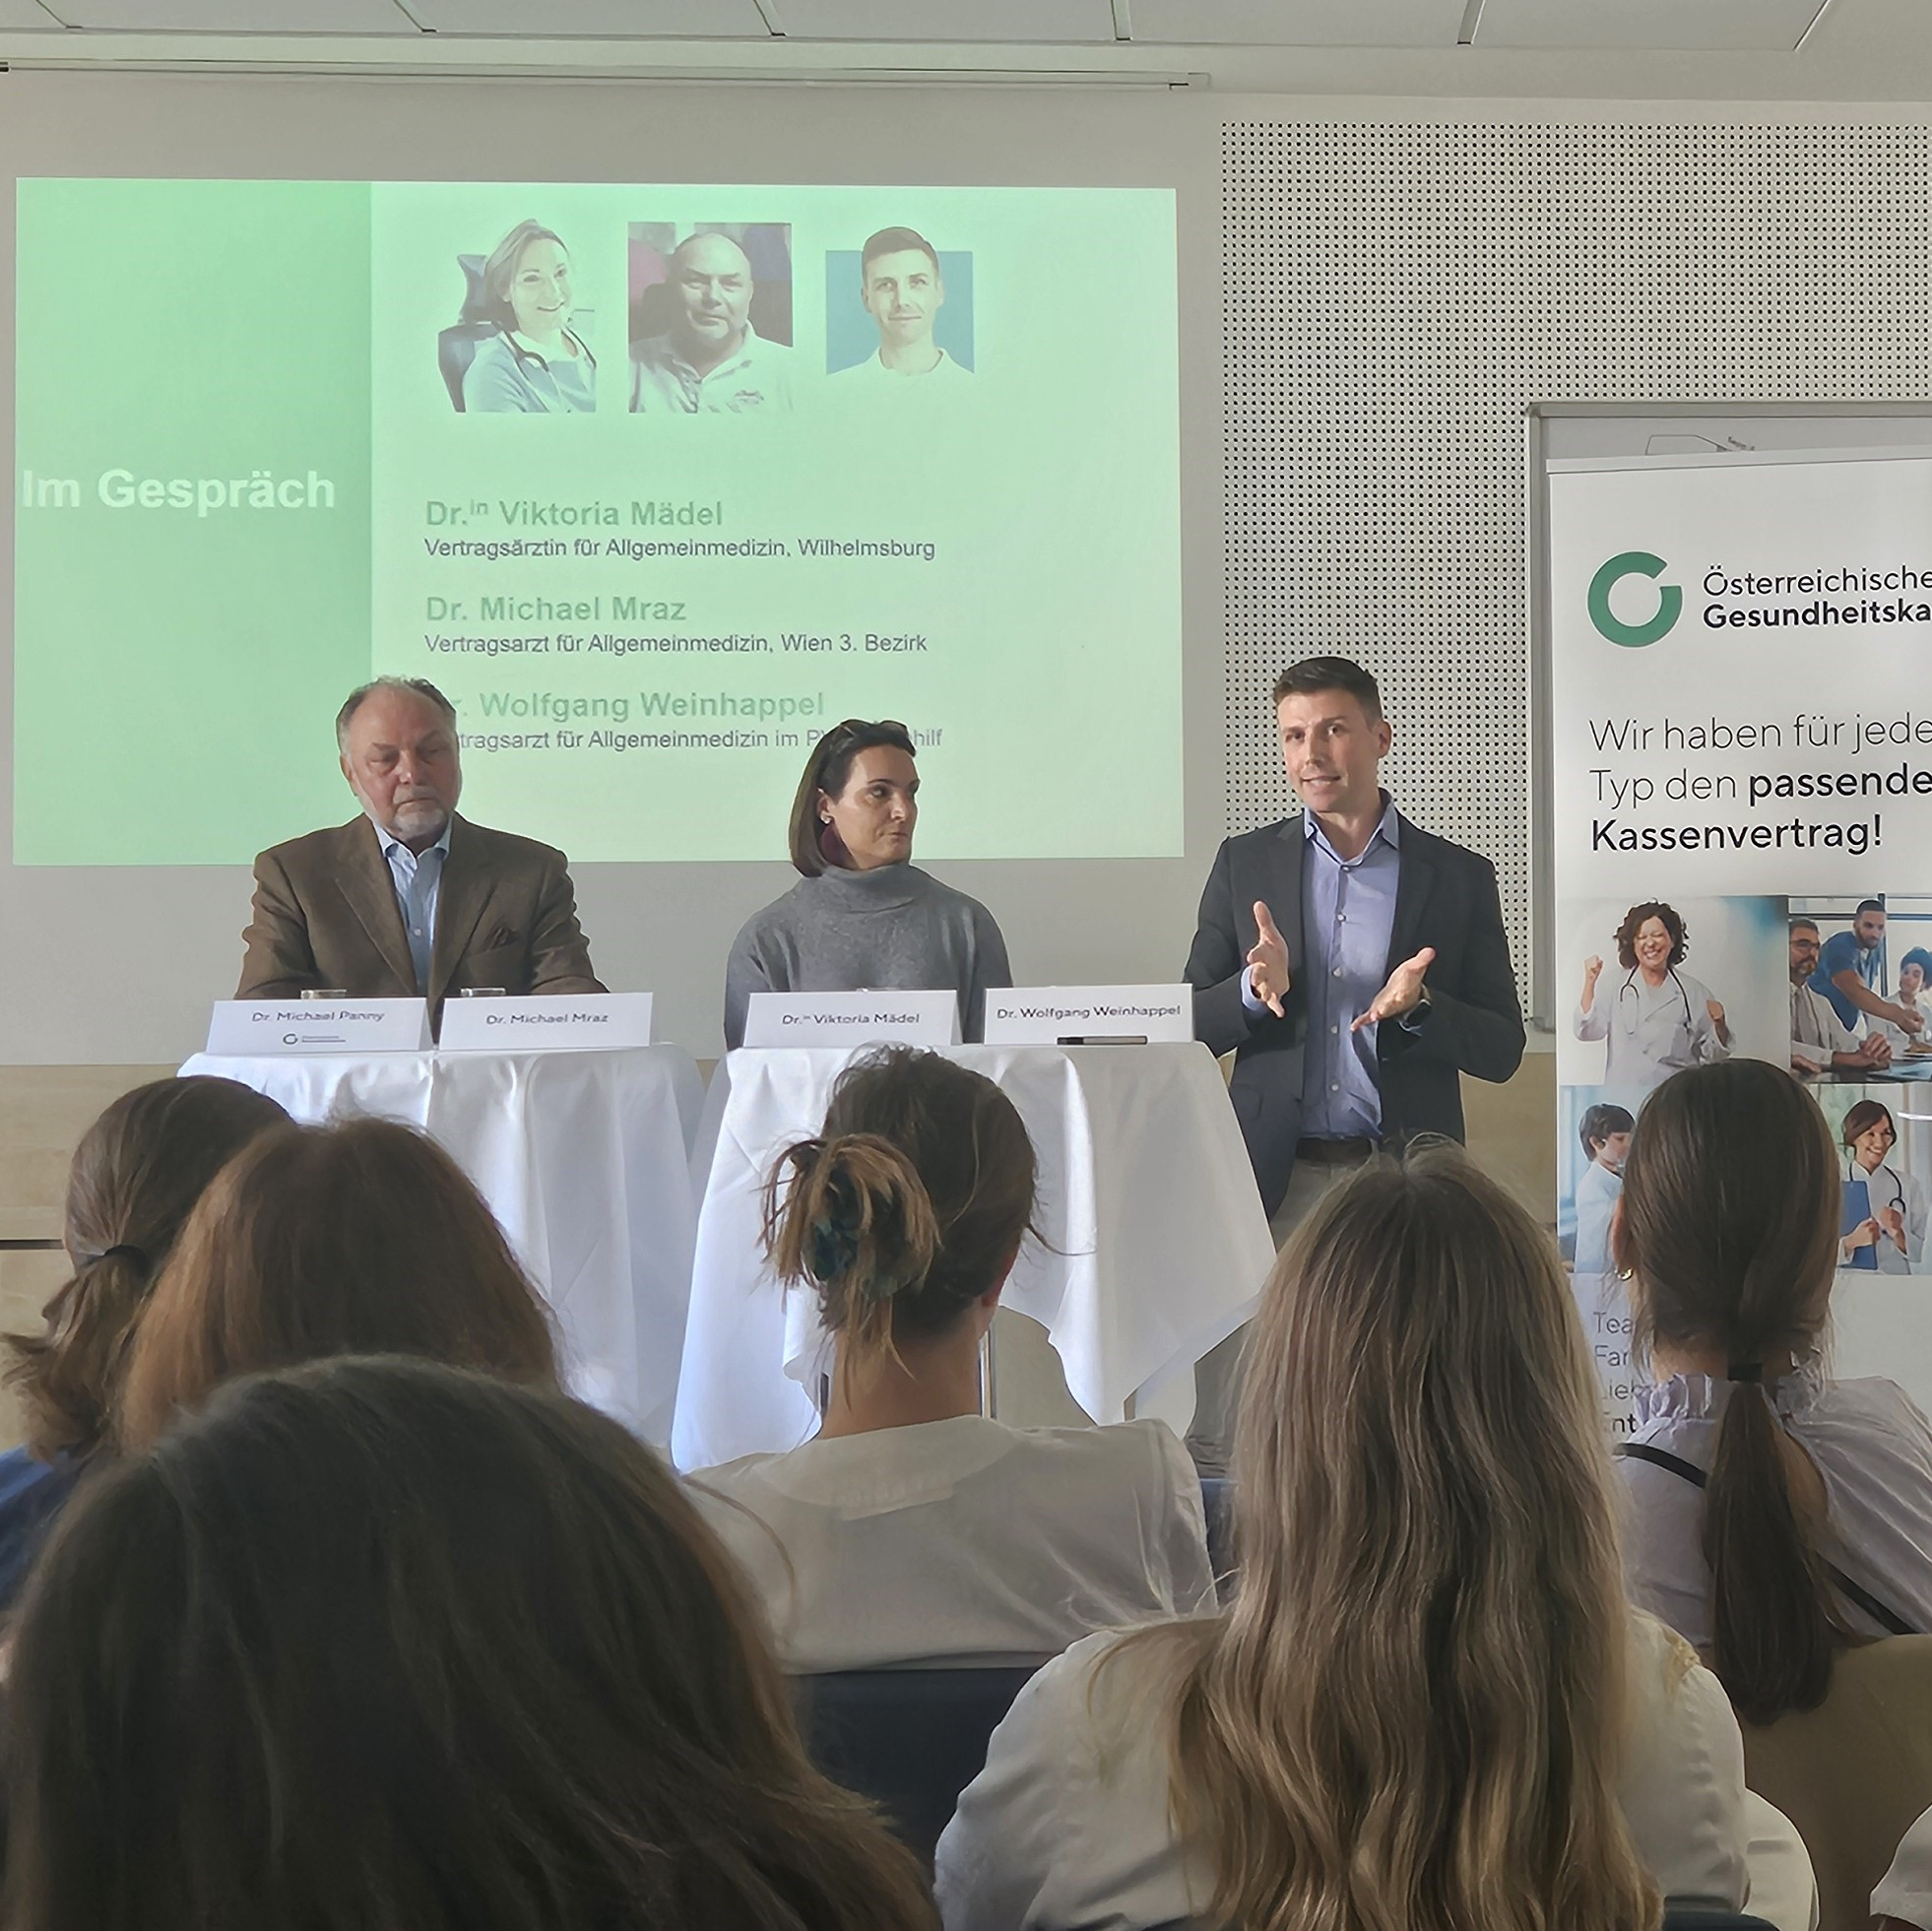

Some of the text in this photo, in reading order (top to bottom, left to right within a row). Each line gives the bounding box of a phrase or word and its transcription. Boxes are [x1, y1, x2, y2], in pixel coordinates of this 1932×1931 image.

[24, 469, 335, 518] Im Gespräch
[499, 500, 619, 526] Viktoria
[631, 500, 723, 526] Mädel
[424, 539, 935, 560] Vertragsärztin für Allgemeinmedizin, Wilhelmsburg
[1703, 564, 1932, 596] Österreichische
[426, 597, 687, 621] Dr. Michael Mraz
[424, 634, 928, 656] Vertragsarzt für Allgemeinmedizin, Wien 3. Bezirk
[480, 692, 629, 723] Wolfgang
[640, 692, 824, 722] Weinhappel
[460, 731, 549, 752] tragsarzt
[556, 731, 583, 748] für
[588, 731, 768, 752] Allgemeinmedizin
[775, 730, 799, 746] im
[1589, 718, 1653, 751] Wir
[1664, 717, 1781, 749] haben
[1793, 714, 1845, 747] für
[1589, 769, 1654, 809] Typ
[1665, 768, 1736, 800] den
[1592, 814, 1882, 856] Kassenvertrag!
[277, 1010, 335, 1021] Michael
[485, 1013, 609, 1025] Dr. Michael Mraz
[813, 1014, 869, 1024] Viktoria
[874, 1013, 920, 1024] Mädel
[997, 1005, 1182, 1020] Dr. Wolfgang Weinhappel
[1593, 1312, 1633, 1334] Tea
